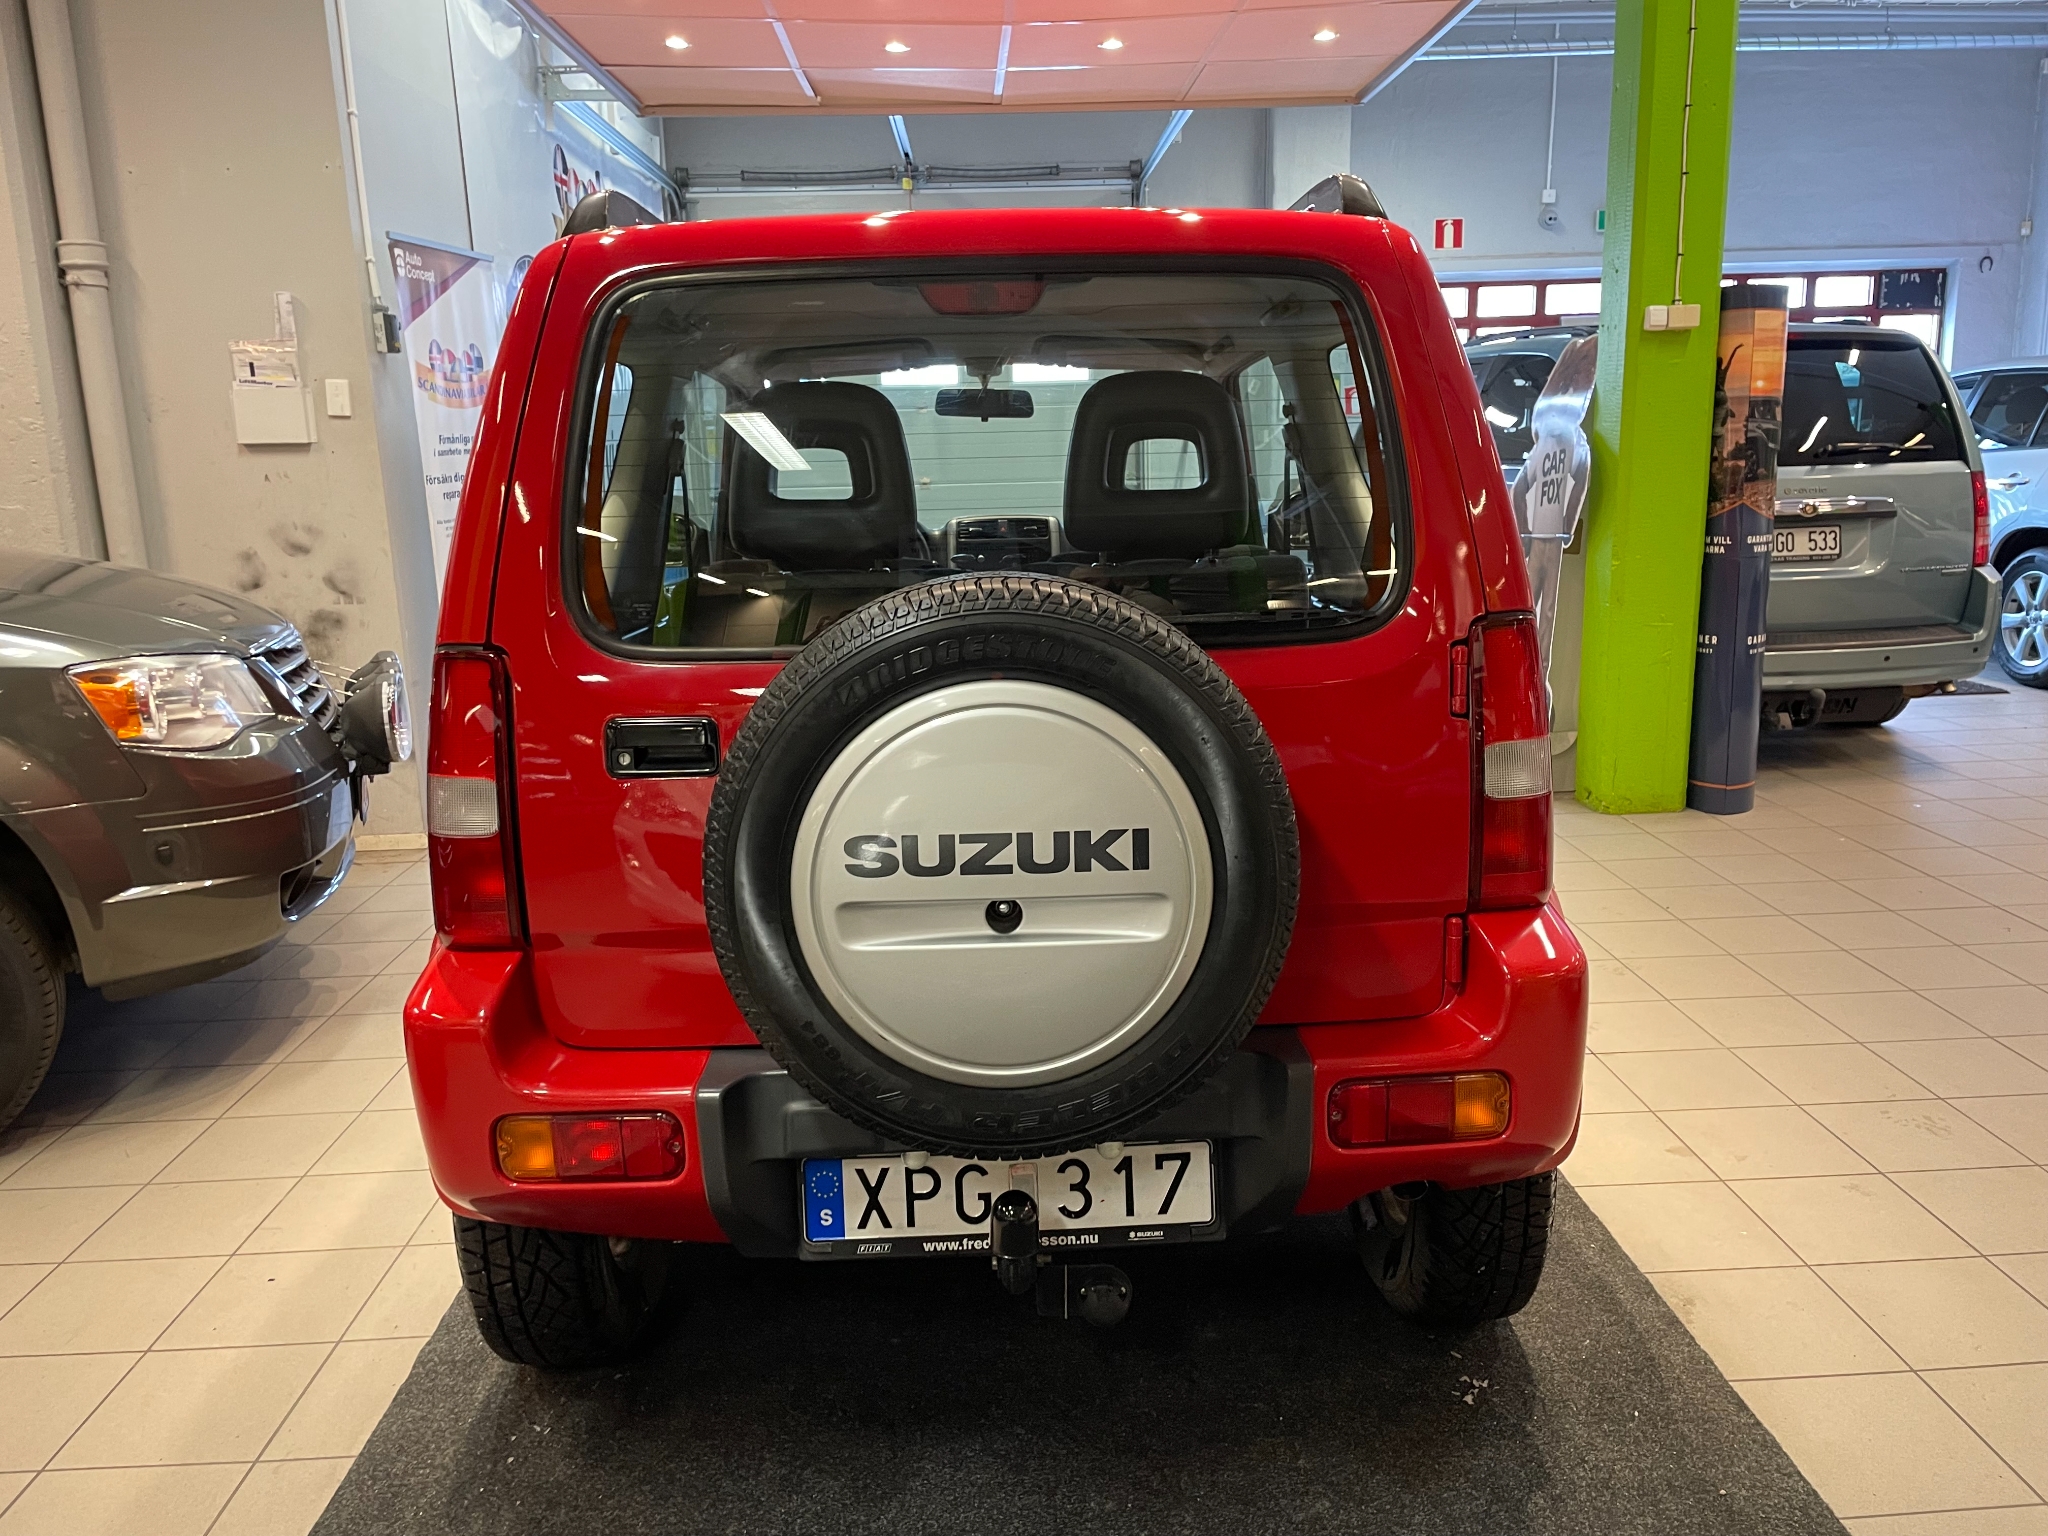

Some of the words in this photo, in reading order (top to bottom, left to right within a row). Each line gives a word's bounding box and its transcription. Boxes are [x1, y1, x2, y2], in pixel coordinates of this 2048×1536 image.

[405, 251, 422, 266] Auto
[406, 266, 435, 284] Concept
[1542, 448, 1567, 478] CAR
[443, 490, 461, 501] repara
[1540, 477, 1562, 507] FOX
[1713, 535, 1732, 544] VILL
[1772, 531, 1795, 553] GO
[1808, 530, 1838, 552] 533
[1705, 545, 1725, 554] ARNA
[1698, 634, 1718, 645] NER
[837, 633, 1118, 708] BRIDGESTONE
[843, 828, 1150, 878] SUZUKI
[855, 1164, 992, 1230] XPG
[1057, 1152, 1191, 1219] 317
[820, 1209, 833, 1226] S
[1136, 1230, 1163, 1238] SUZUKI
[857, 1243, 892, 1254] FIAT
